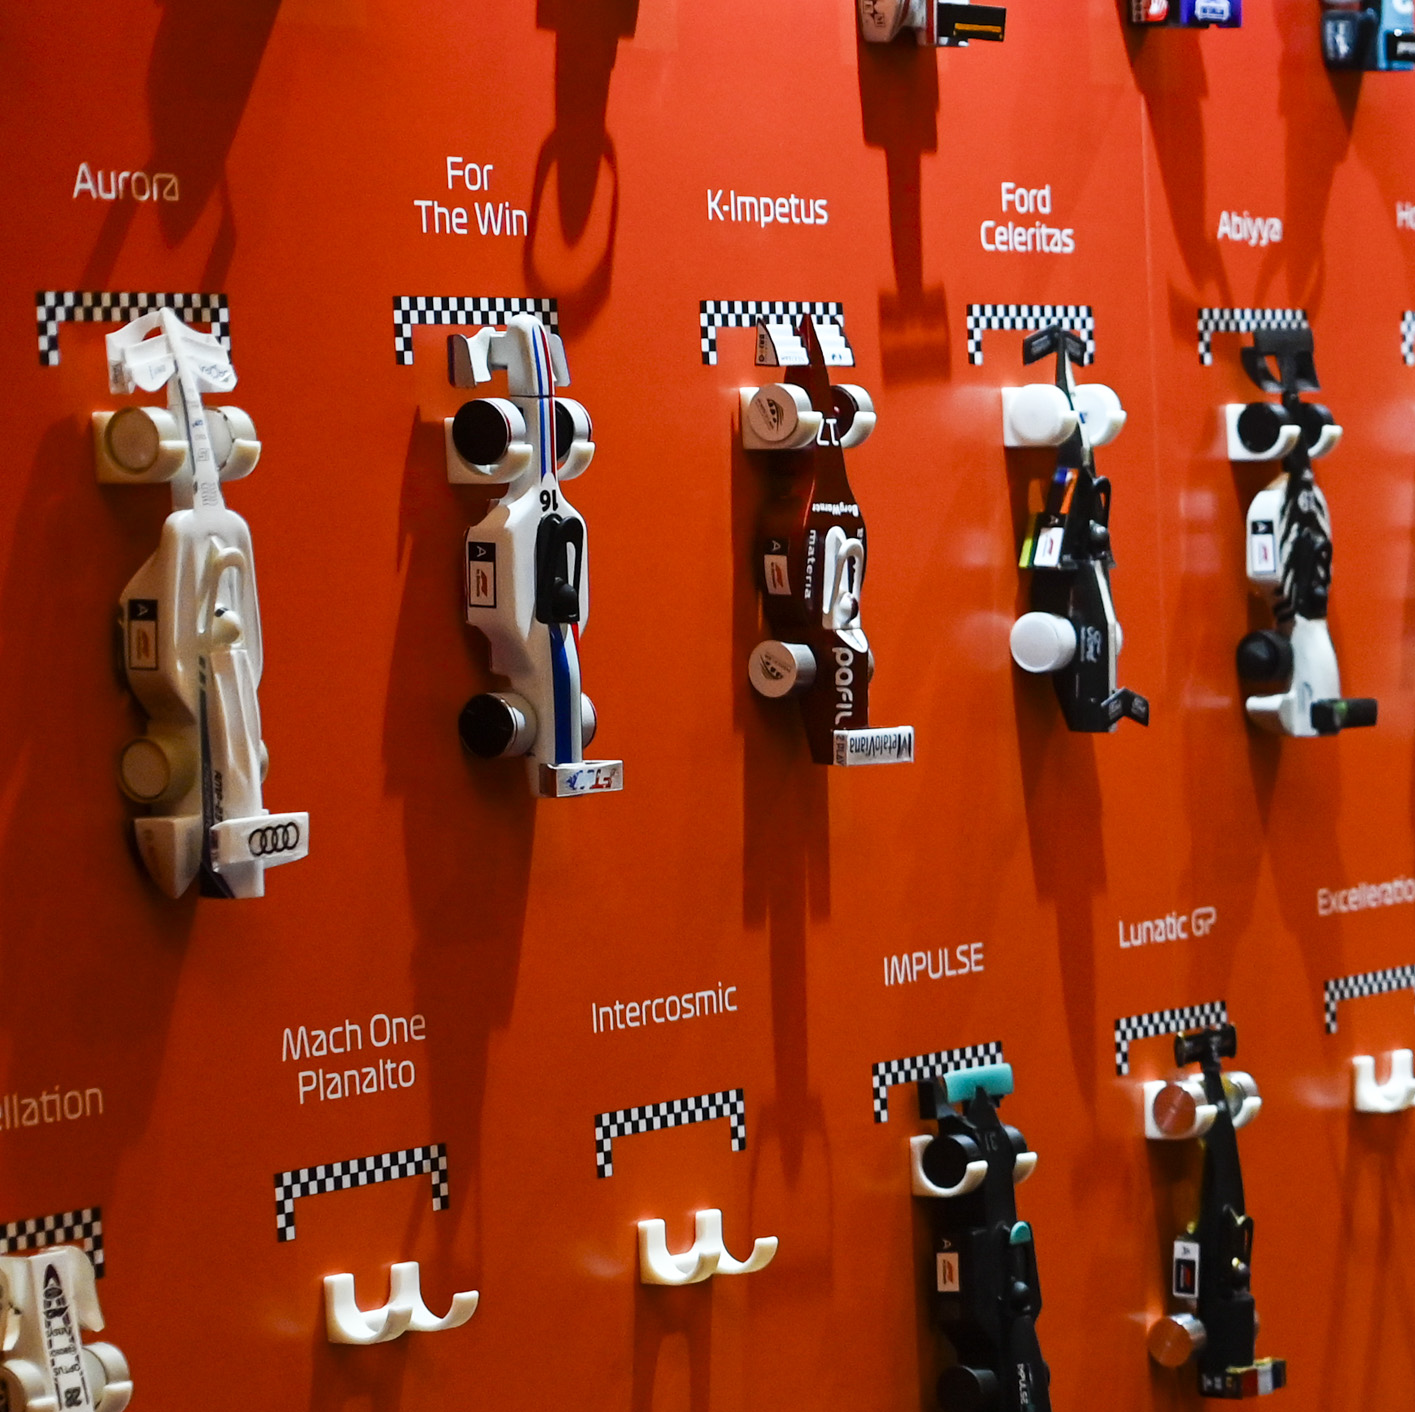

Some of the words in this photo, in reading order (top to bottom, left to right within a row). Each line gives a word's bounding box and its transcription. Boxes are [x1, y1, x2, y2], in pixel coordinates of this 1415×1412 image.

[73, 162, 180, 203] Aurora
[447, 156, 493, 190] For
[708, 189, 828, 228] K-Impetus
[1001, 182, 1051, 214] Ford
[414, 200, 467, 234] The
[476, 202, 527, 236] Win
[981, 221, 1075, 253] Celeritas
[1217, 211, 1282, 246] Abiyya
[539, 489, 559, 512] 16
[850, 732, 912, 760] MetaloViana
[1119, 912, 1188, 948] Lunatic
[1191, 907, 1216, 936] GP
[884, 943, 984, 986] IMPULSE
[592, 982, 737, 1033] Intercosmic
[281, 1017, 361, 1062] Mach
[370, 1014, 425, 1047] One
[298, 1059, 416, 1105] Planalto
[0, 1084, 103, 1130] llation
